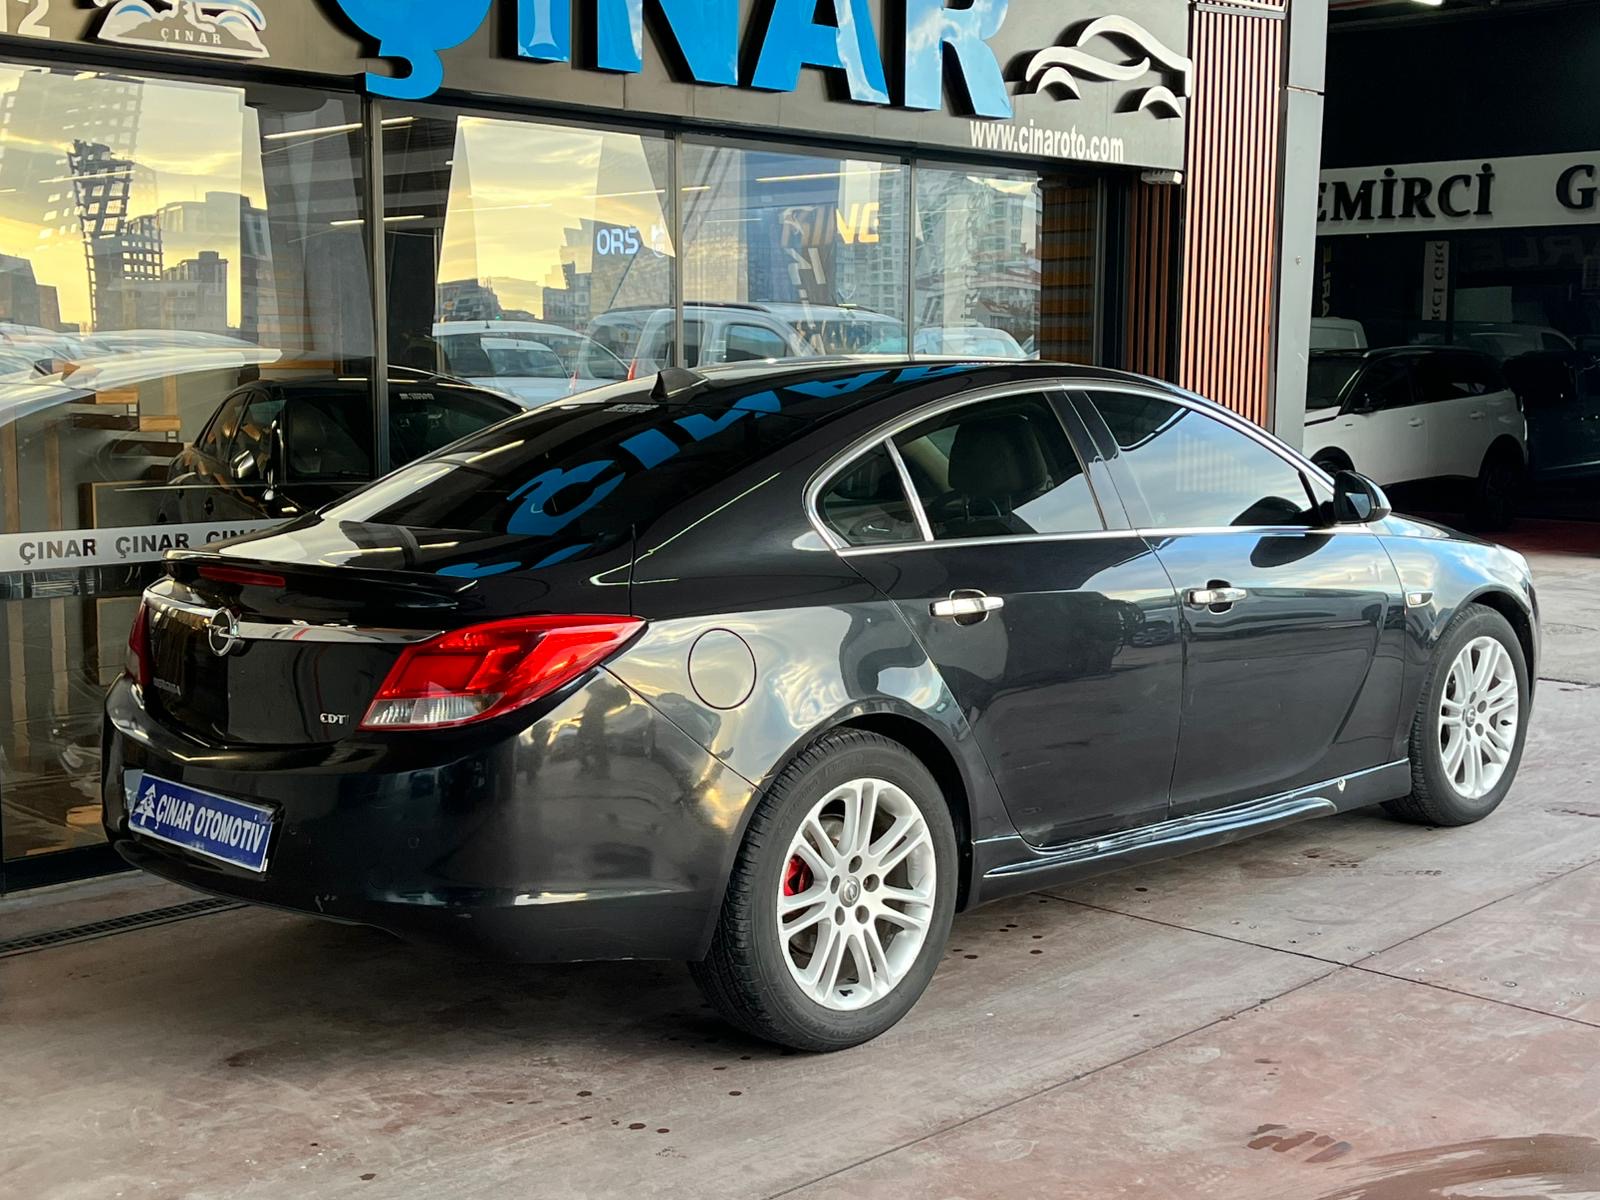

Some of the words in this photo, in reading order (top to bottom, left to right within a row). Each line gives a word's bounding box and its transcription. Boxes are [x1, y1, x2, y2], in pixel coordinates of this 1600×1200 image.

[161, 28, 221, 44] ÇINAR
[969, 119, 1124, 162] www.cinaroto.com
[19, 538, 97, 565] ÇINAR
[115, 533, 190, 559] ÇINAR
[155, 794, 194, 831] ÇINAR
[194, 806, 266, 854] OTOMOTİV
